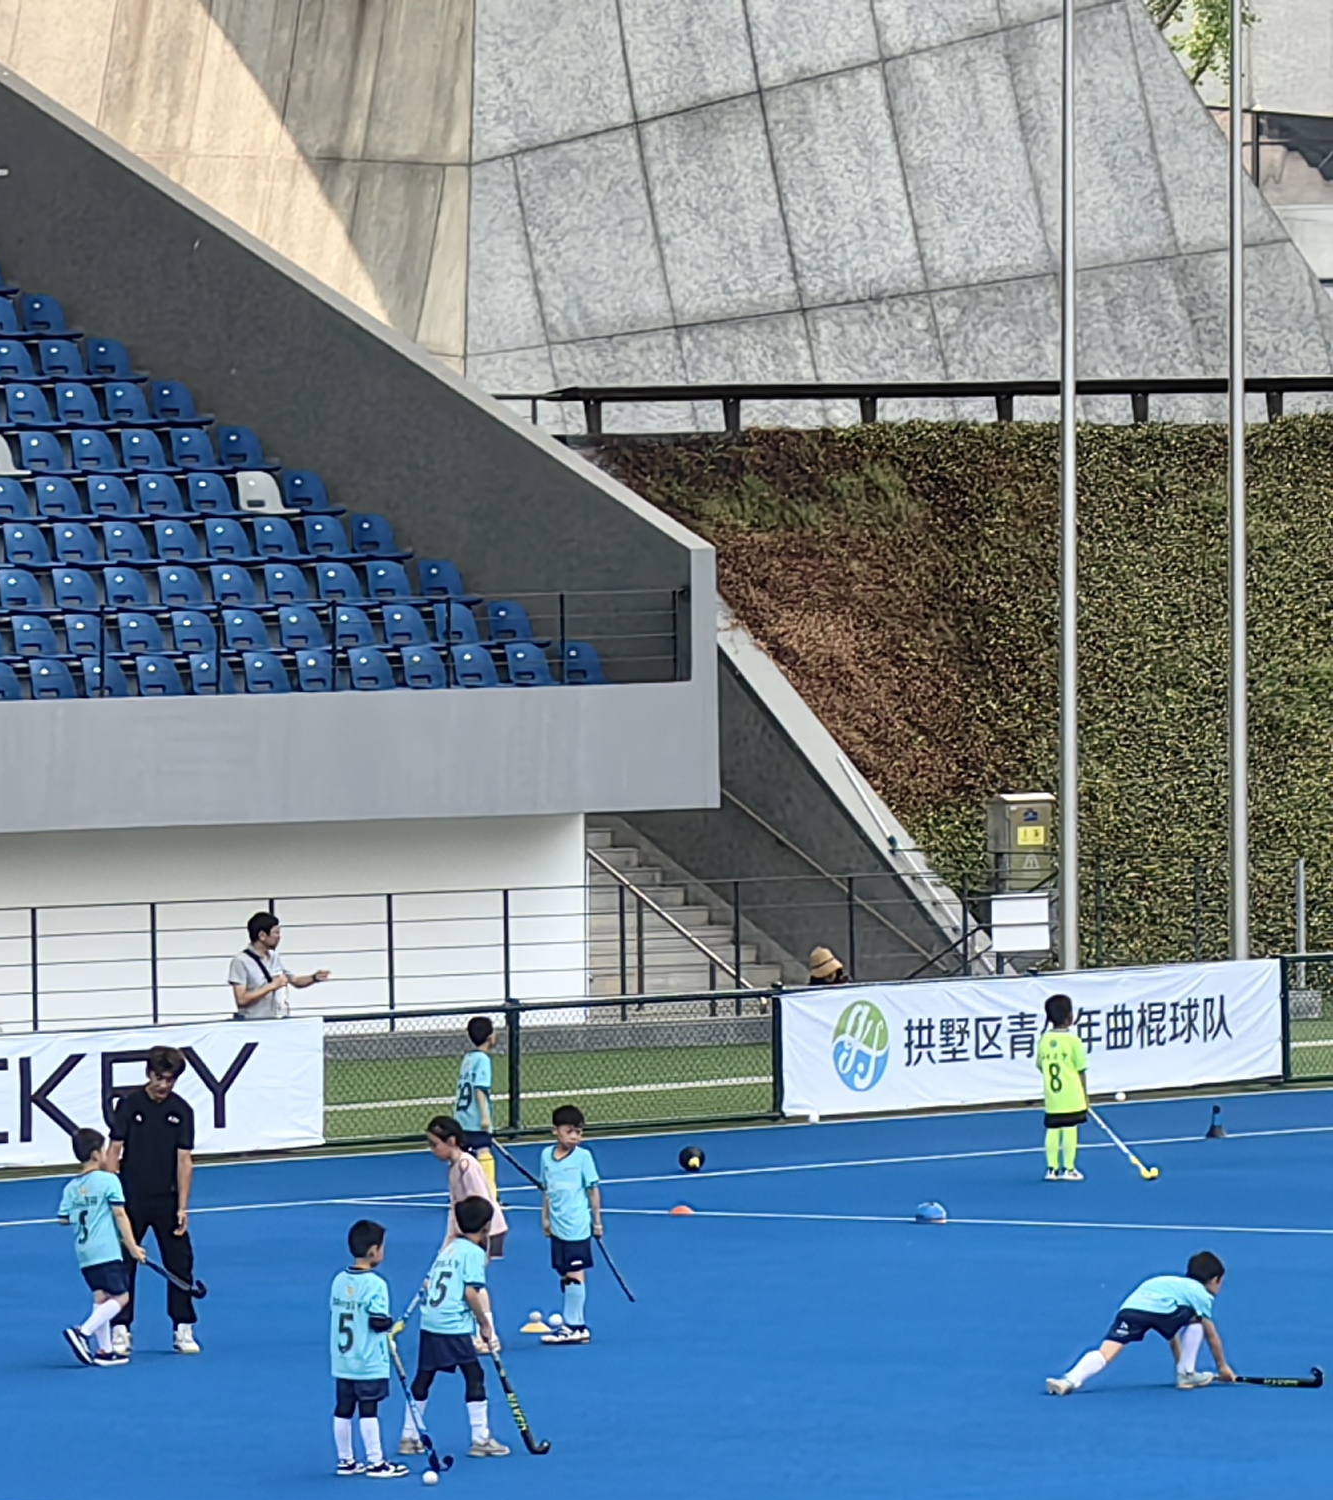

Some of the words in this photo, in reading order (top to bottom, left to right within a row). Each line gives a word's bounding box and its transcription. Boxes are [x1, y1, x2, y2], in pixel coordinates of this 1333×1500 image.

[903, 995, 1233, 1068] 拱墅区青年曲棍球队
[1048, 1062, 1062, 1093] 8
[337, 1312, 354, 1354] 5
